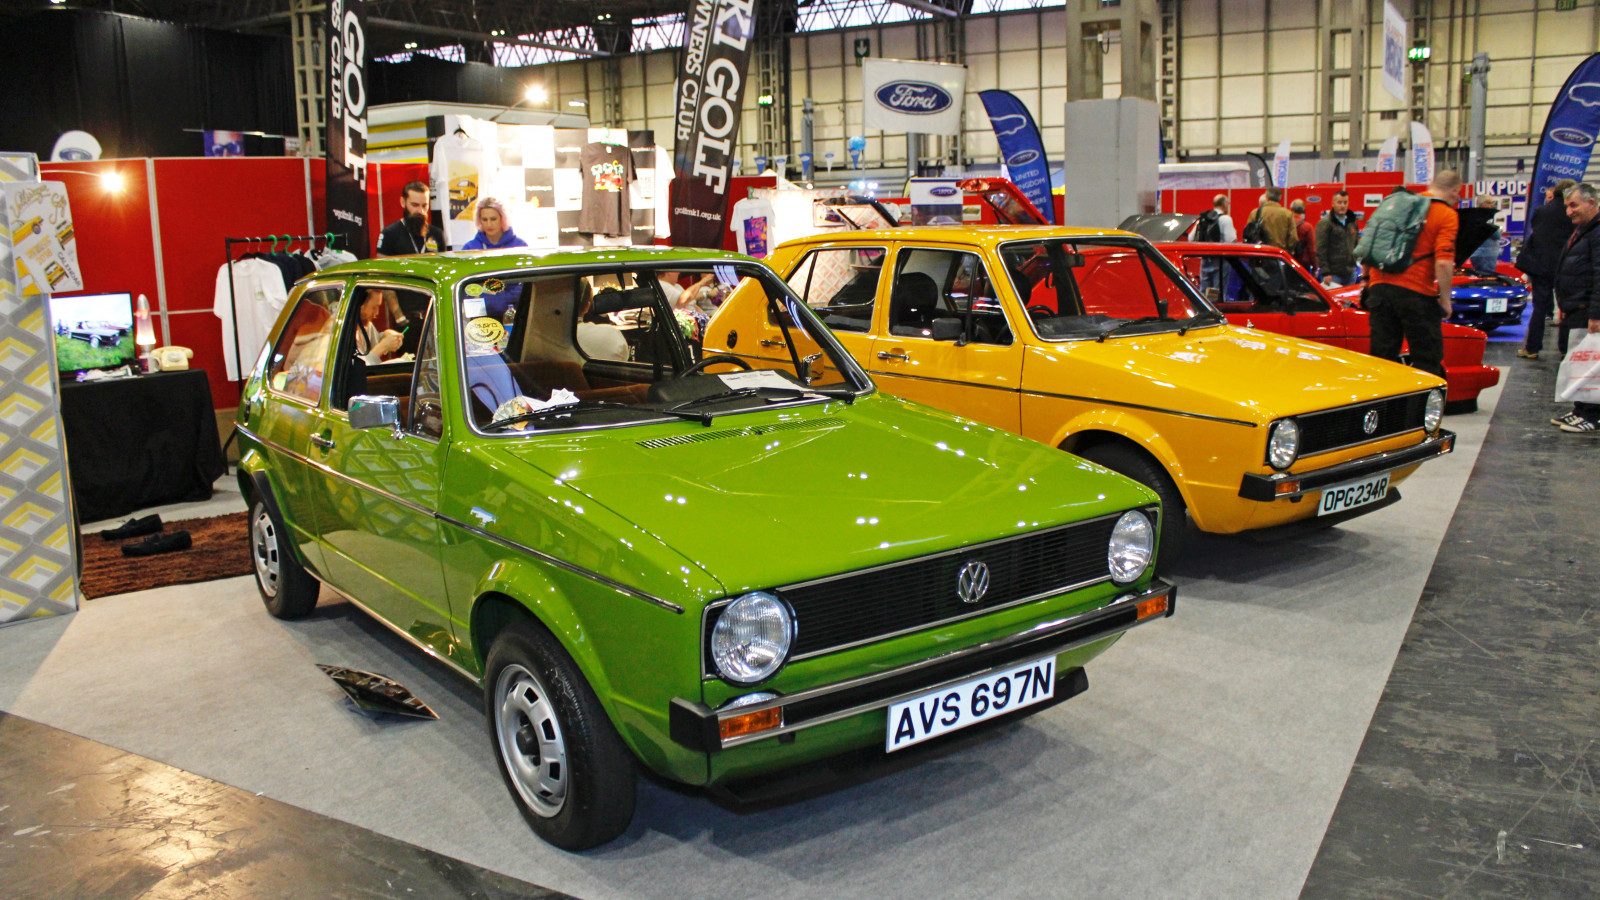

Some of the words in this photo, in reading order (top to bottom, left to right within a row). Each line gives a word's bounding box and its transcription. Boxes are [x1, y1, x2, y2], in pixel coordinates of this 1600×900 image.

[331, 35, 341, 120] CLUB
[343, 10, 367, 191] GOLF
[889, 84, 938, 110] Ford
[677, 79, 699, 141] CLUB
[693, 57, 740, 195] GOLF
[1015, 169, 1040, 181] UNITED
[1541, 163, 1584, 177] KINGDOM
[1549, 152, 1581, 165] UNITED
[894, 692, 961, 745] AVS
[970, 661, 1052, 718] 697N
